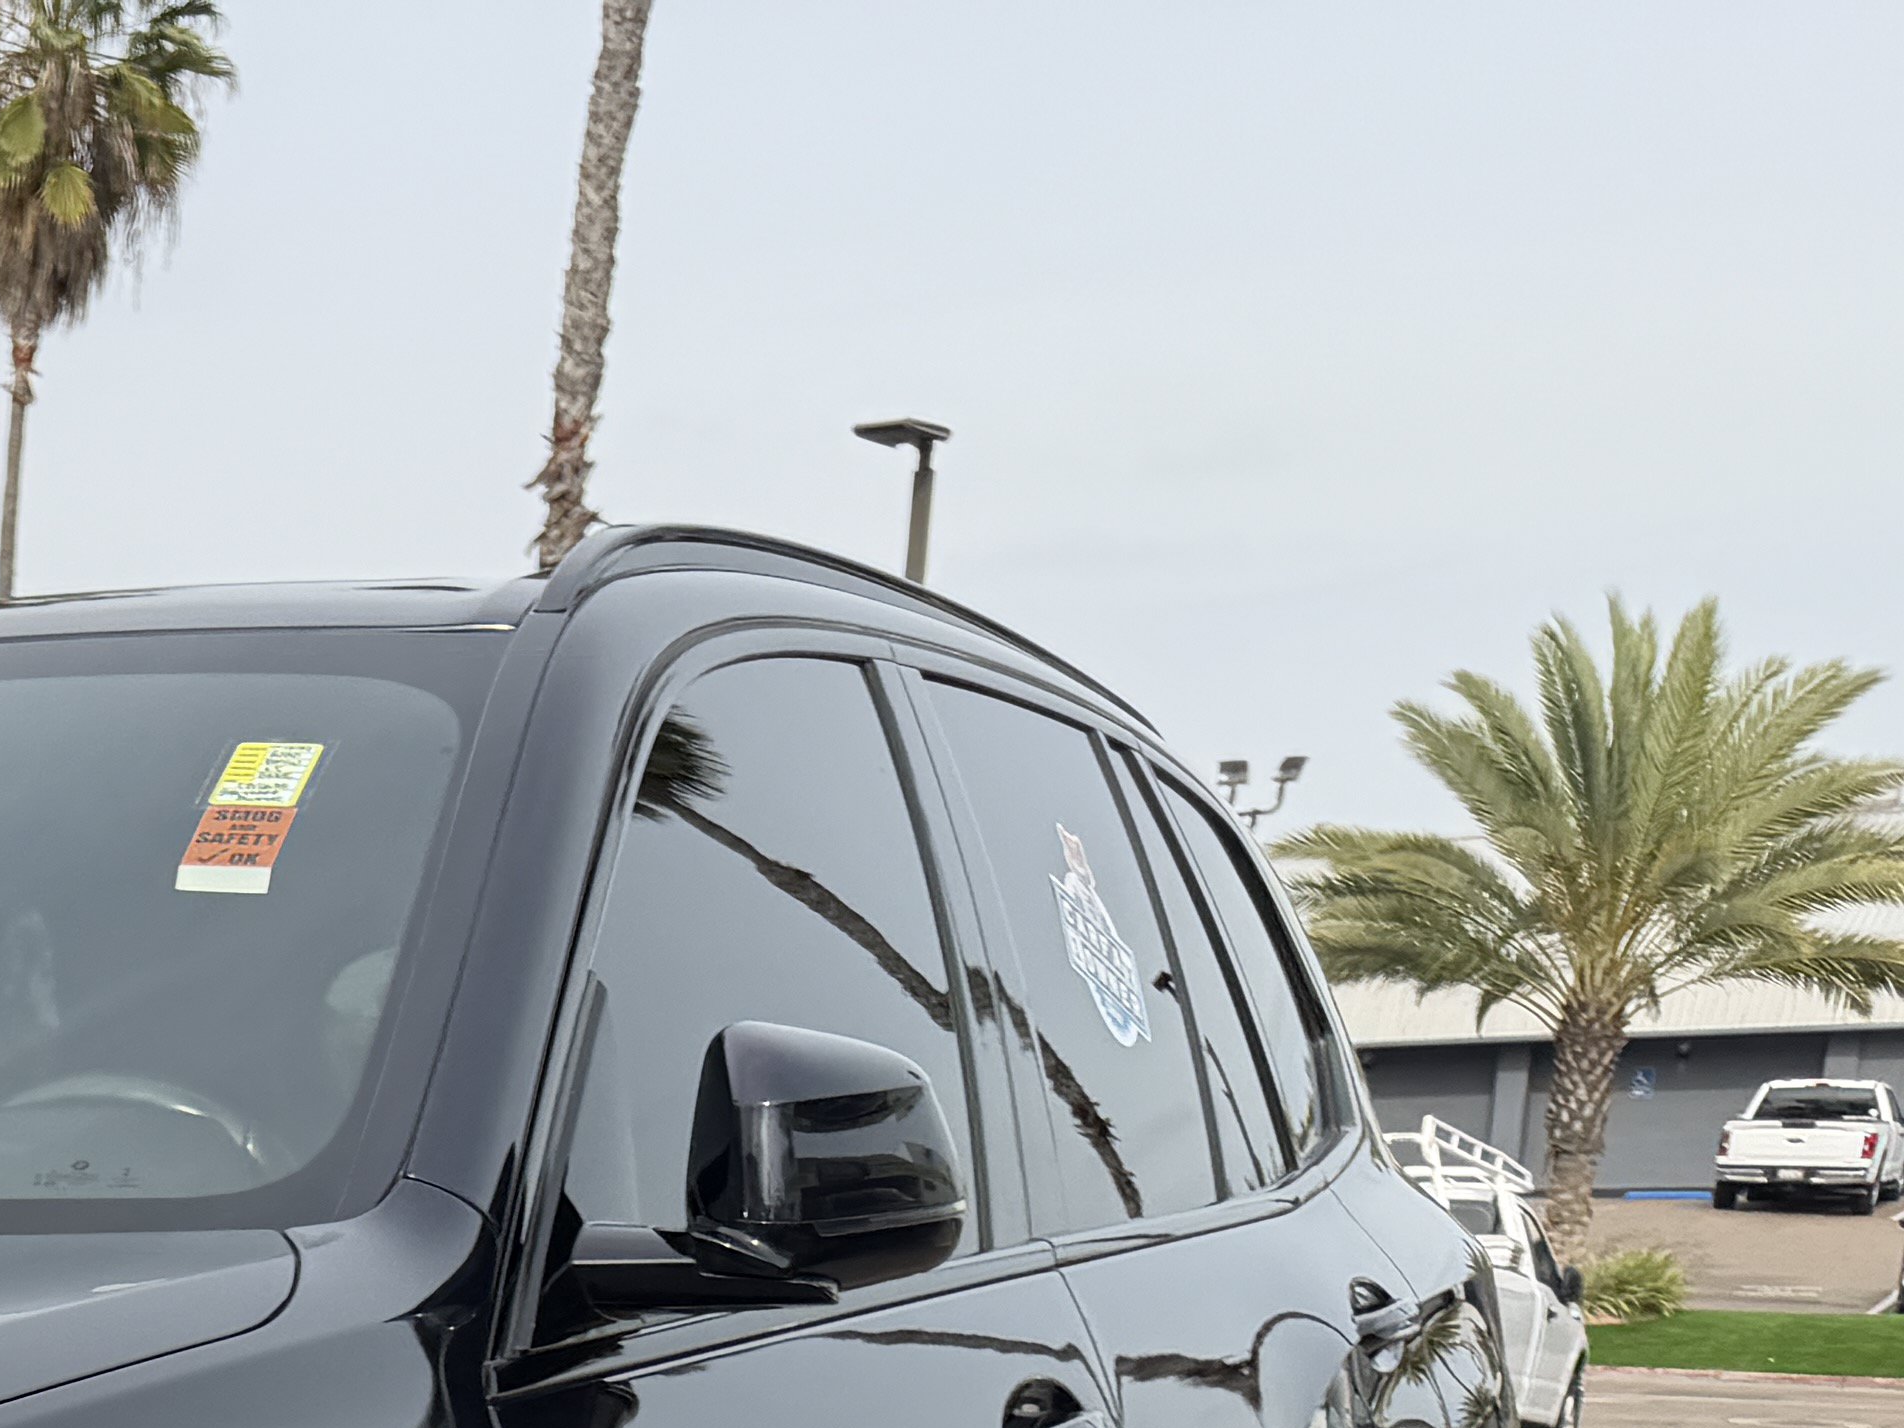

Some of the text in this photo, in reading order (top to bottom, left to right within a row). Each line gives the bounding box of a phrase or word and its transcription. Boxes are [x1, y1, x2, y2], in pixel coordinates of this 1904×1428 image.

[213, 809, 282, 824] SMOG
[195, 832, 279, 847] SAFETY
[229, 853, 260, 866] OK
